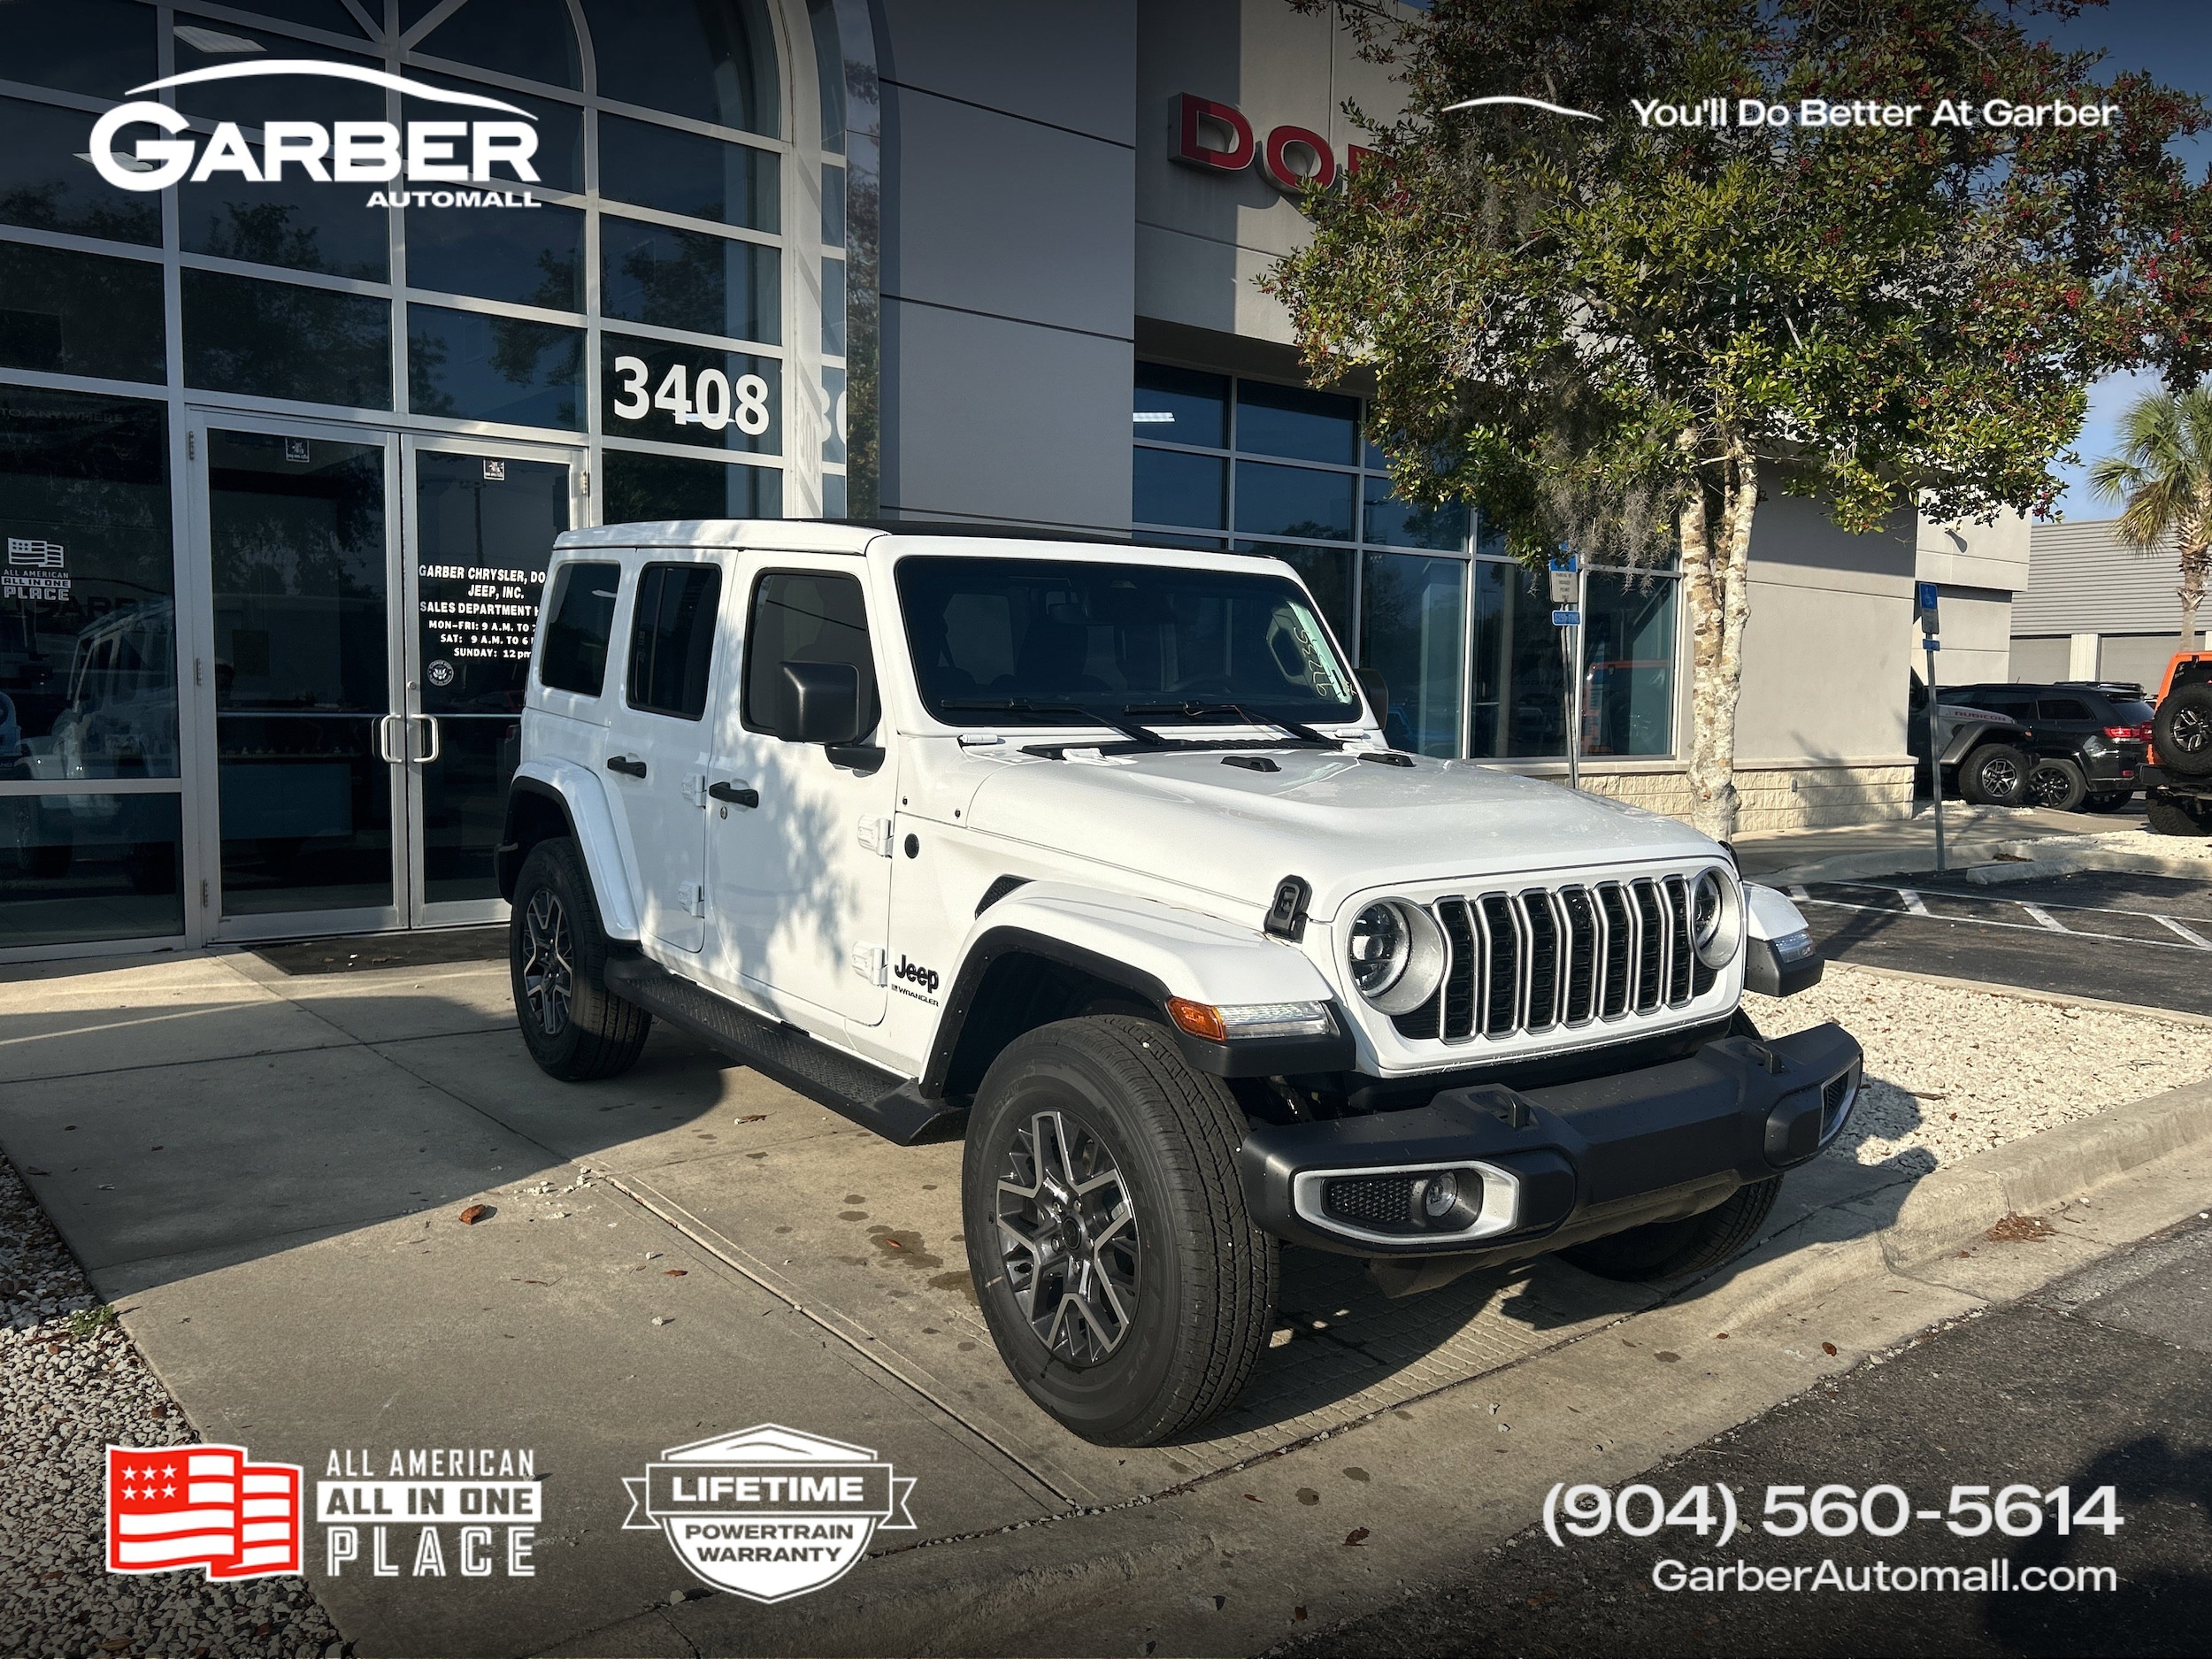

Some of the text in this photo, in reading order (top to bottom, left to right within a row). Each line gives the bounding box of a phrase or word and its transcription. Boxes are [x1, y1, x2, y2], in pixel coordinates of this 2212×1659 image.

[614, 356, 771, 435] 3408
[23, 570, 70, 579] AMERICAN
[419, 565, 465, 580] GARBER
[467, 566, 528, 585] CHRYSLER,
[44, 579, 70, 588] ONE
[4, 586, 70, 602] PLACE
[467, 584, 525, 601] JEEP, INC.
[419, 601, 457, 614] SALES
[457, 602, 532, 617] DEPARTMENT
[428, 619, 480, 631] MON-FRI:
[481, 622, 488, 631] 9
[491, 623, 514, 633] A.M.
[517, 623, 530, 633] TO
[440, 634, 463, 644] SAT:
[470, 635, 479, 644] 9
[480, 635, 503, 645] A.M.
[506, 635, 519, 645] TO
[521, 636, 529, 645] 6
[453, 648, 497, 657] SUNDAY:
[1955, 710, 2007, 722] RUBICON
[894, 954, 940, 994] Jeep
[898, 986, 940, 1006] WRANGLER
